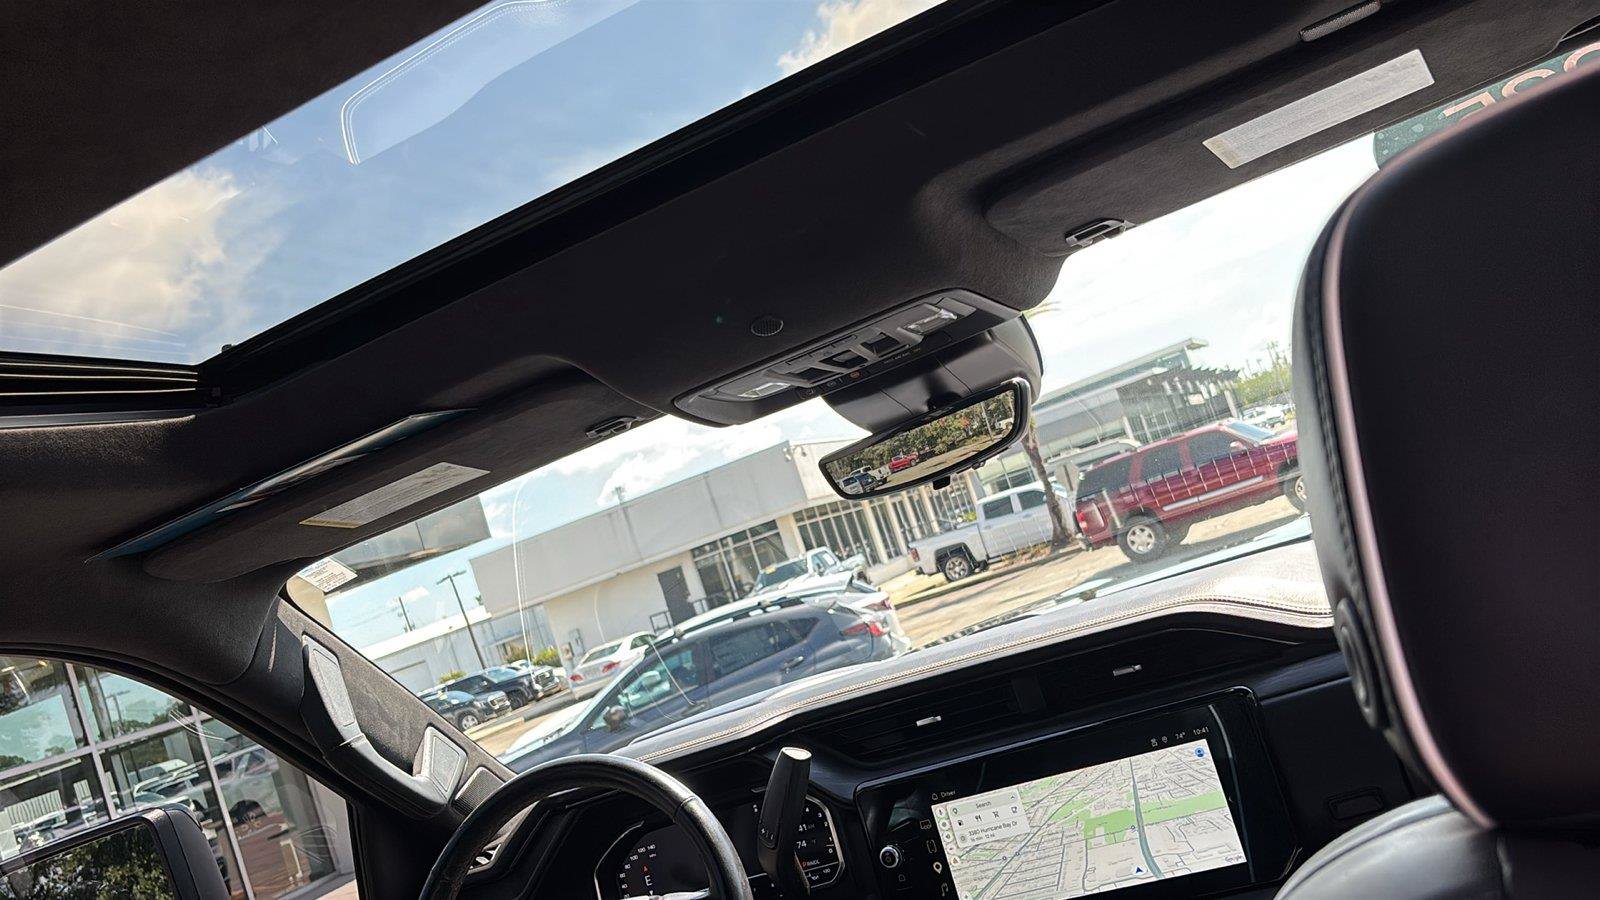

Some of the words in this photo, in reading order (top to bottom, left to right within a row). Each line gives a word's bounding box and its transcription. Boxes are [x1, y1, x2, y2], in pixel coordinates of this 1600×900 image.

[1193, 726, 1209, 736] 10:41
[940, 790, 956, 798] Driver
[975, 801, 992, 809] Search
[644, 875, 653, 886] E
